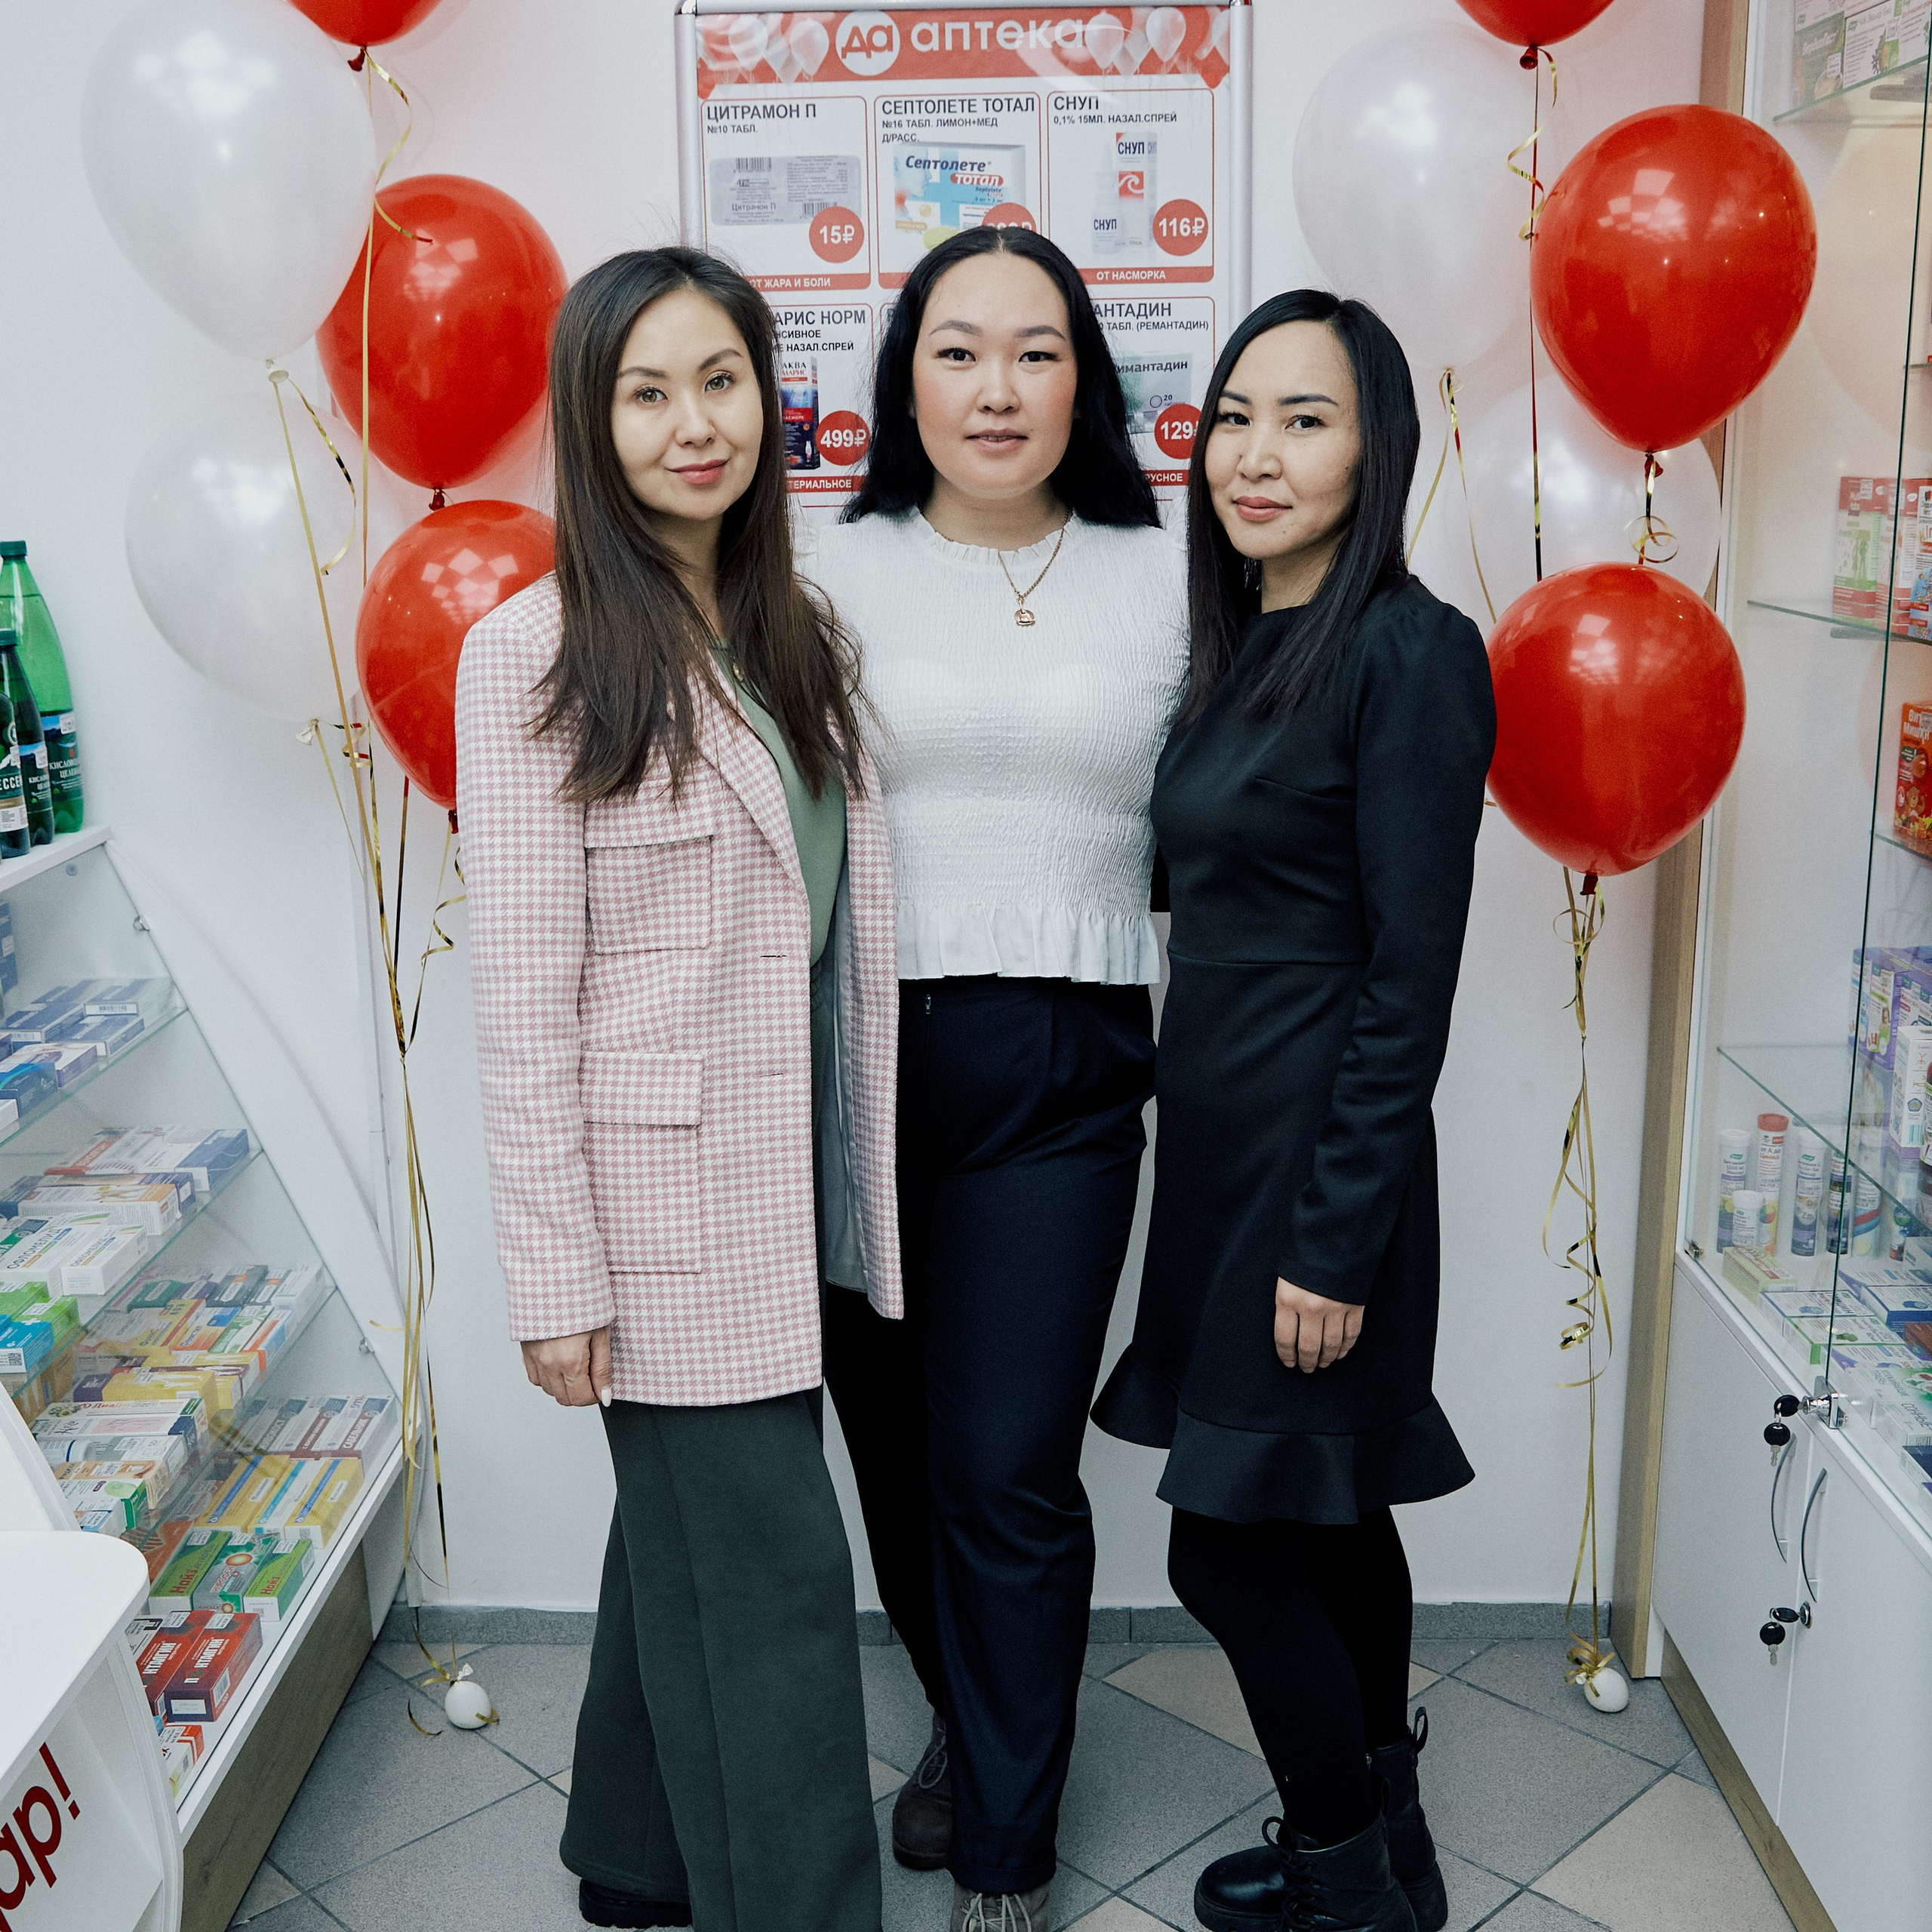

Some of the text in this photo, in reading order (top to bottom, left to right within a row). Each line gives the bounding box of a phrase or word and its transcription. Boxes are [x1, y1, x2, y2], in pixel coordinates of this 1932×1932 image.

[841, 19, 1084, 59] да аптека
[881, 97, 1035, 115] СЕПТОЛЕТЕ ТОТАЛ
[1054, 96, 1100, 110] СНУП
[706, 103, 817, 122] ЦИТРАМОН П
[1054, 112, 1177, 125] 0,1% 15МЛ. НАЗАЛ.СПРЕЙ
[707, 125, 758, 134] №10 ТАБЛ.
[881, 118, 998, 128] №16 ТАБЛ. ЛИМОН+МЕД
[881, 133, 921, 144] Д/РАСС.
[1118, 141, 1145, 155] СНУП
[906, 155, 987, 172] Септолете
[955, 174, 999, 186] тотал
[731, 203, 768, 212] Цитрамон
[1094, 218, 1117, 230] СНУП
[1158, 217, 1205, 237] 116₽
[820, 224, 856, 245] 15₽
[749, 277, 831, 288] ОТ ЖАРА И БОЛИ
[1097, 270, 1166, 281] ОТ НАСМОРКА
[774, 309, 866, 326] АРИС НОРМ
[1094, 302, 1171, 320] АНТАДИН
[1106, 321, 1134, 331] ТАБЛ.
[1136, 320, 1209, 332] (РЕМАНТАДИН)
[774, 330, 821, 340] НСИВНОЕ
[786, 340, 854, 352] НАЗАЛ.СПРЕЙ
[1117, 360, 1188, 374] имантадин
[1161, 420, 1199, 440] 129
[820, 429, 866, 448] 499₽
[1145, 472, 1183, 482] РУСНОЕ
[788, 479, 852, 490] ТЕРИАЛЬНОЕ
[7, 1227, 64, 1269] ОФЛОМЕЛИД
[170, 1569, 198, 1594] Найз
[260, 1577, 280, 1595] Найз
[143, 1642, 177, 1688] НТАЛГИН
